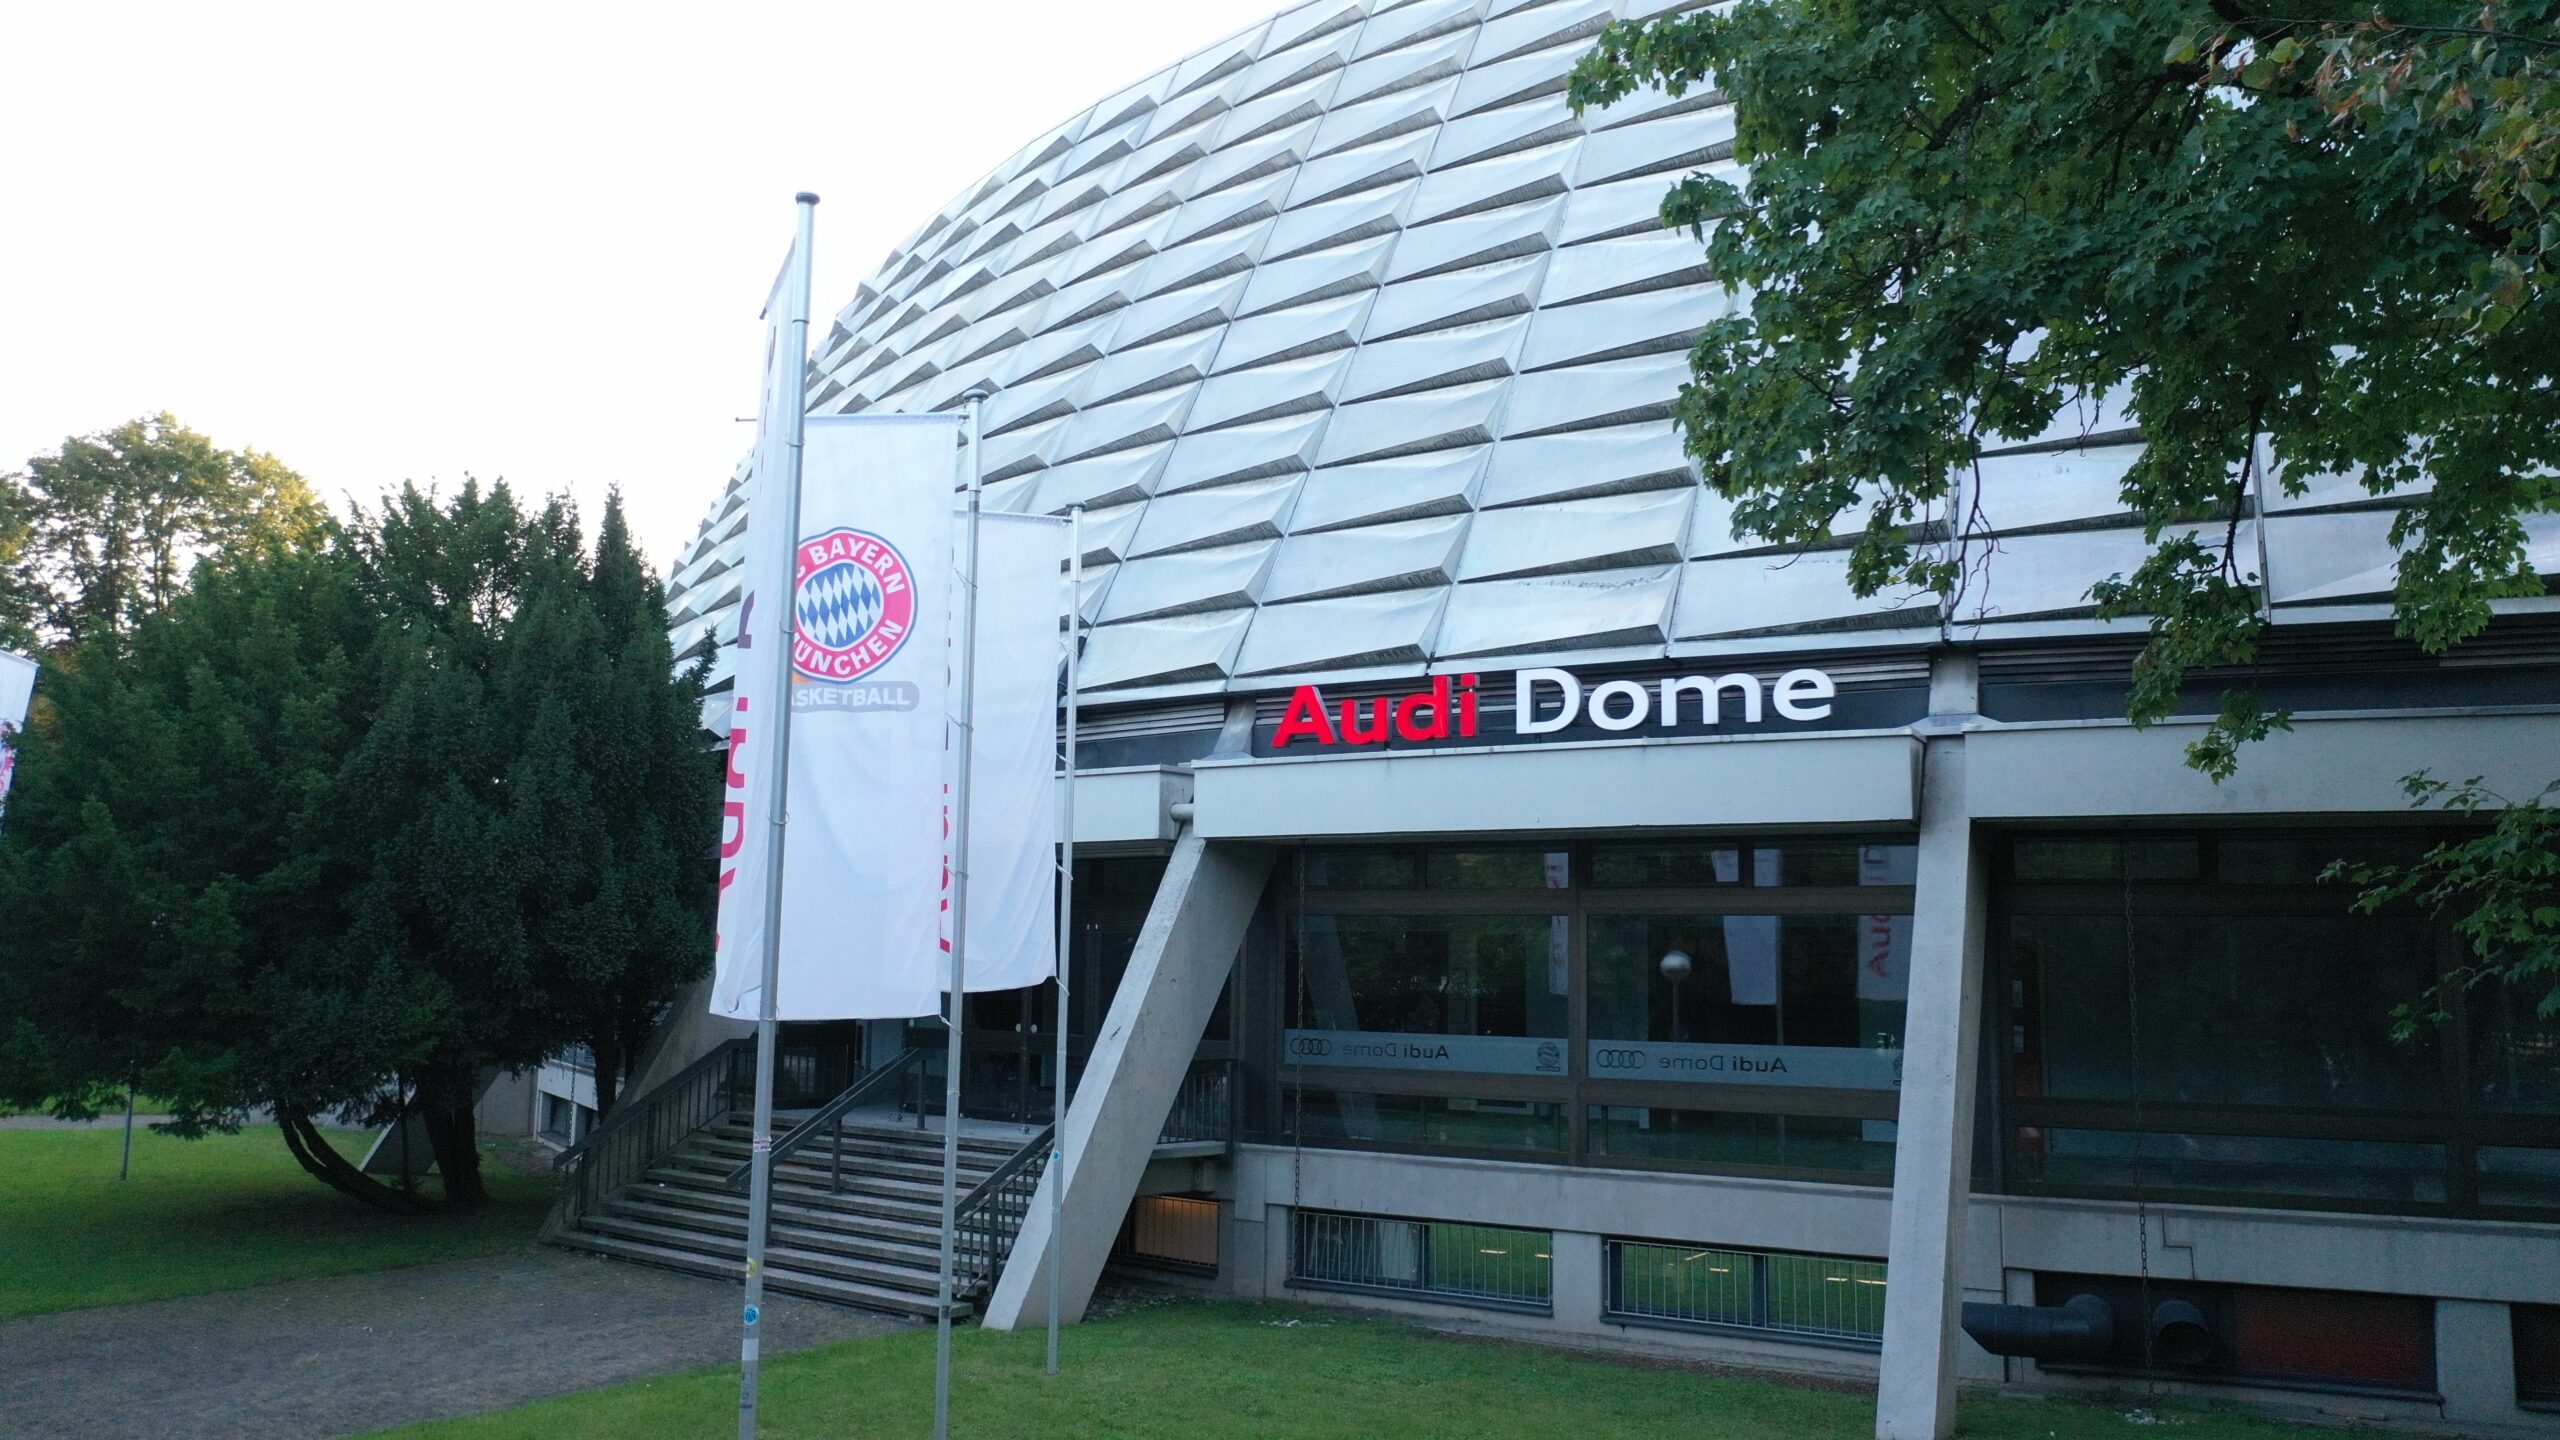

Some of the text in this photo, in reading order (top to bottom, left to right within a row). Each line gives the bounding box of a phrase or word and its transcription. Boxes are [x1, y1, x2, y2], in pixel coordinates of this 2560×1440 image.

[808, 537, 905, 595] BAYERN
[793, 619, 903, 676] ÜNCHEN
[792, 687, 910, 707] SKETBALL
[1270, 667, 1837, 748] Audi Dome
